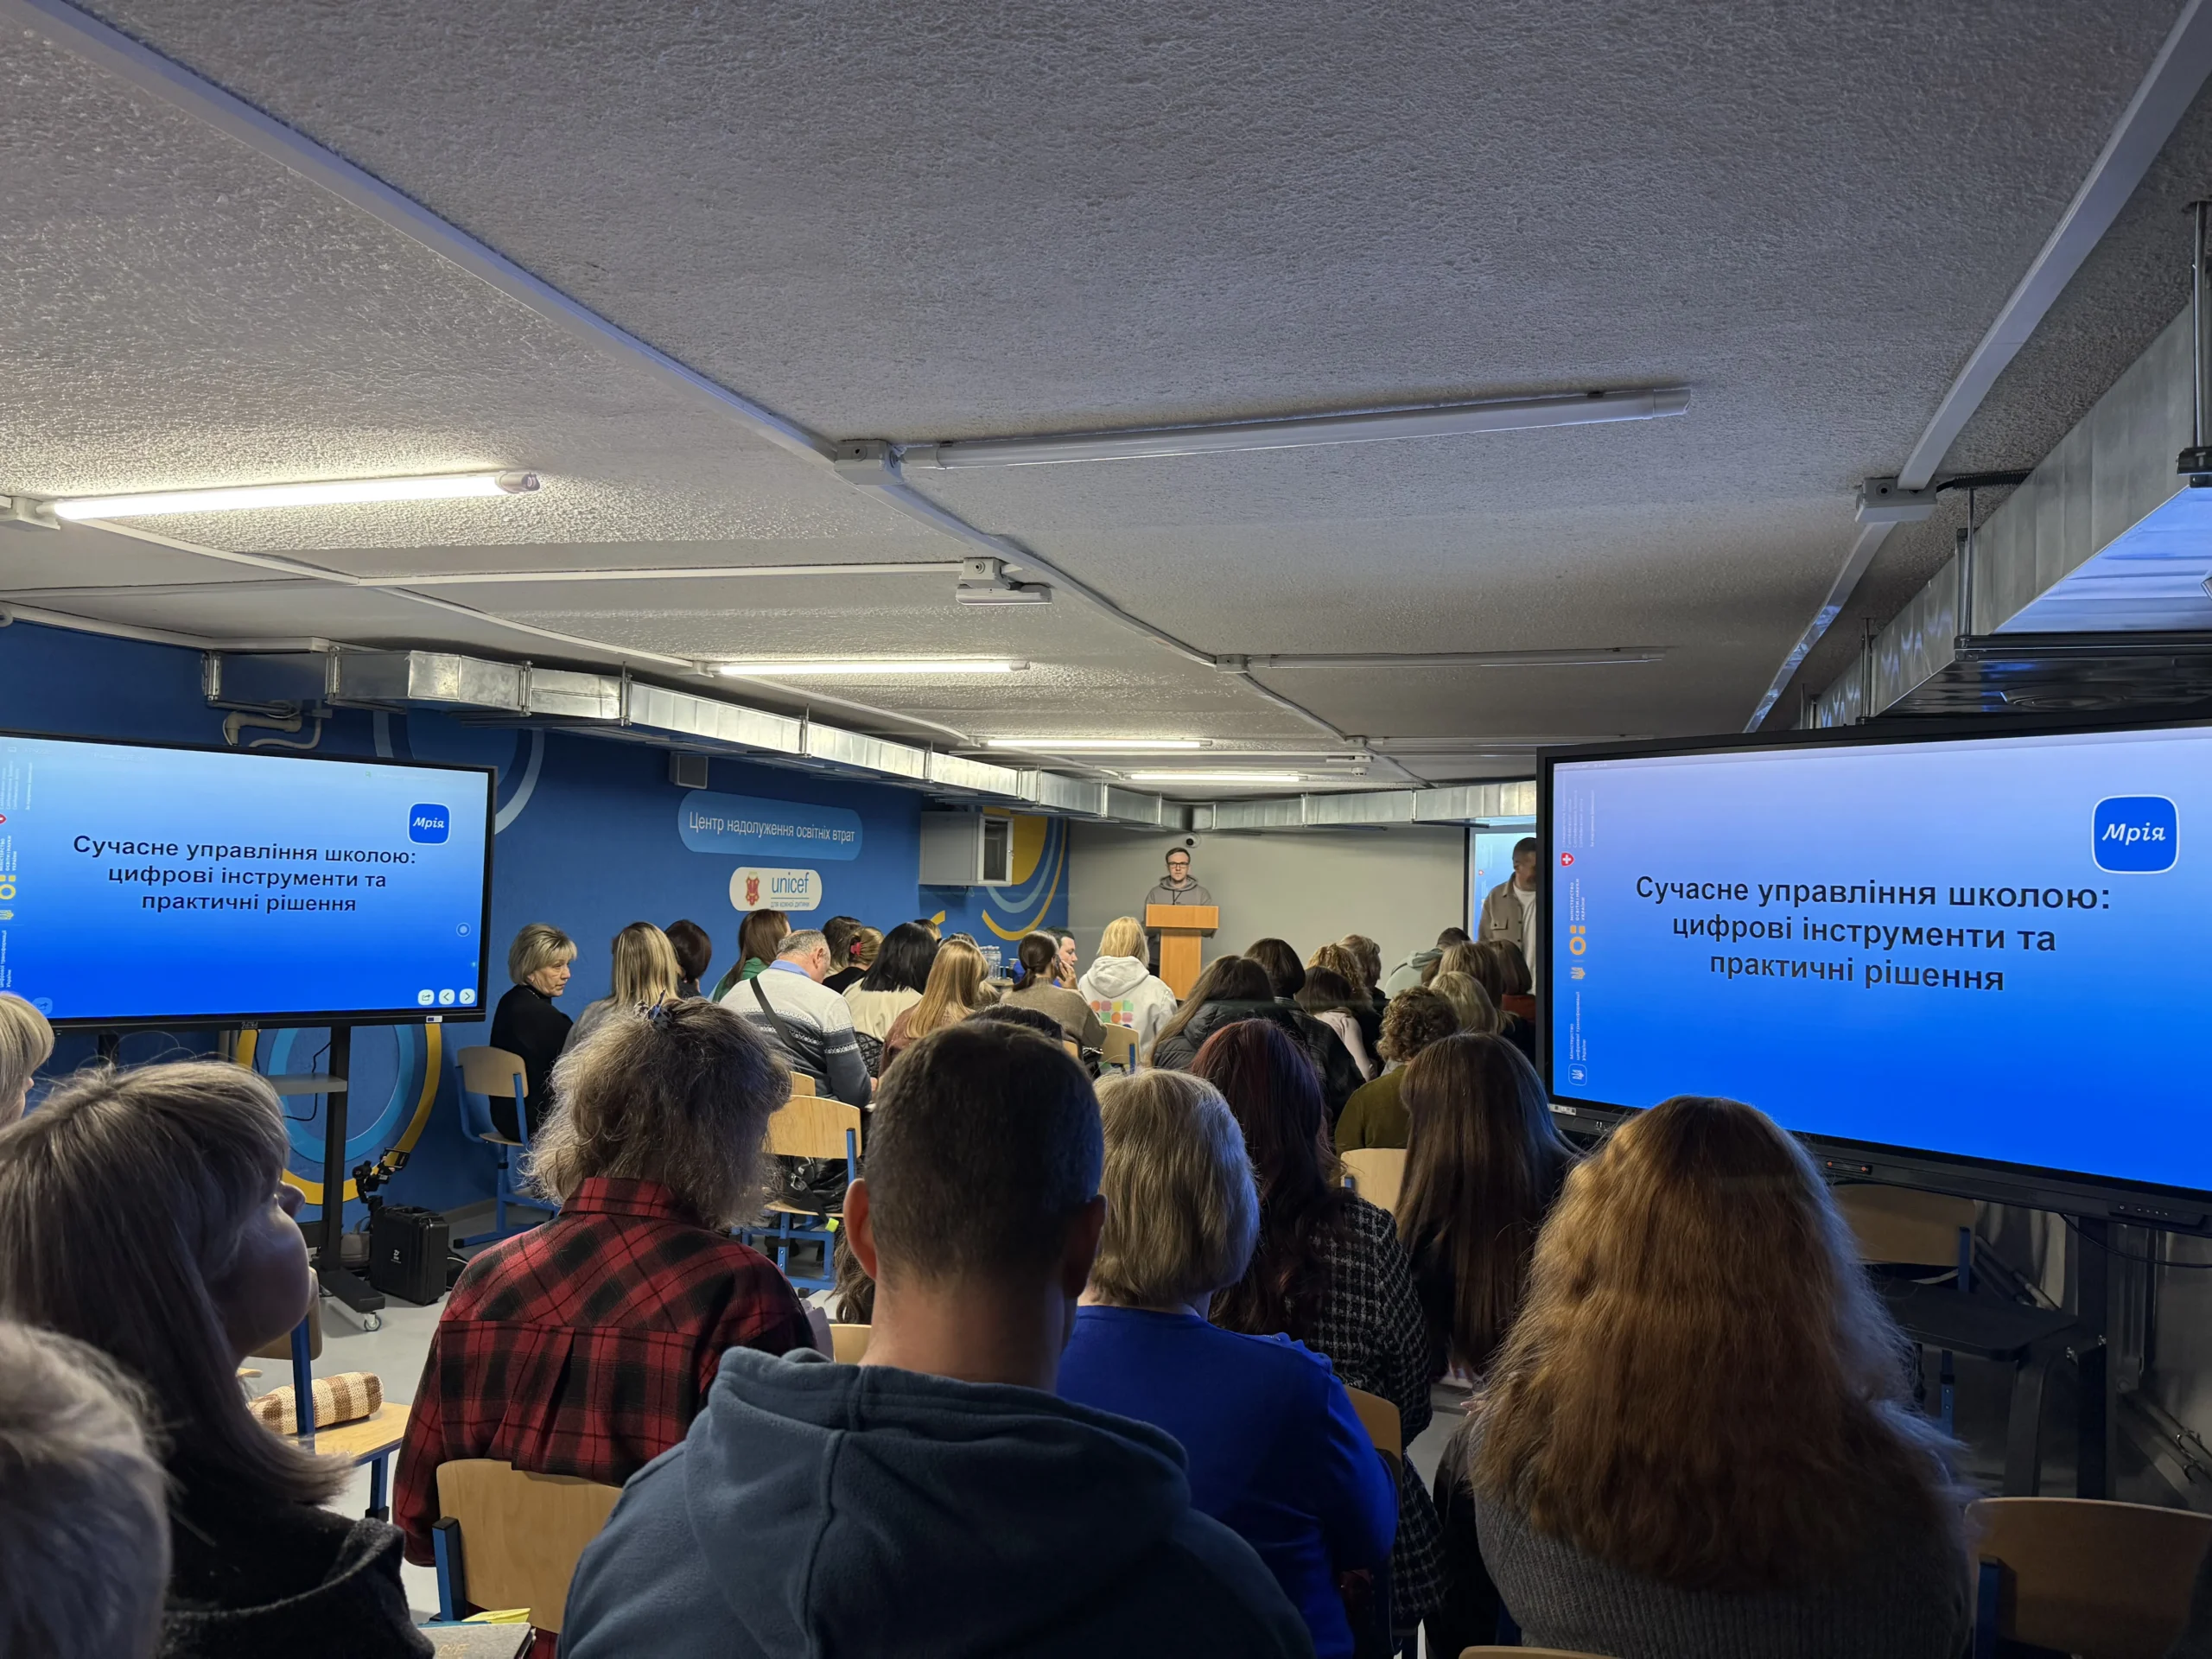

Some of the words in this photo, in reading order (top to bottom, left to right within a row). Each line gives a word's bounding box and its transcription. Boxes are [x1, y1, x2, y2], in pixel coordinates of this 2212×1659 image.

[413, 817, 444, 830] Мрія
[690, 812, 723, 835] Центр
[728, 820, 793, 838] надолуження
[797, 825, 830, 840] освітніх
[832, 830, 855, 844] втрат
[2102, 823, 2165, 845] Мрія
[74, 836, 178, 857] Сучасне
[187, 843, 316, 861] управління
[326, 850, 415, 863] школою:
[109, 866, 213, 886] цифрові
[222, 868, 357, 889] інструменти
[365, 876, 385, 887] та
[772, 872, 809, 893] unicef
[143, 894, 257, 912] практичні
[267, 895, 355, 913] рішення
[1637, 876, 1748, 904] Сучасне
[1758, 880, 1935, 907] управління
[1950, 887, 2108, 909] школою:
[1674, 914, 1790, 943] цифрові
[1804, 917, 2004, 950] інструменти
[2018, 931, 2056, 950] та
[1712, 957, 1853, 981] практичні
[1866, 960, 2003, 990] рішення
